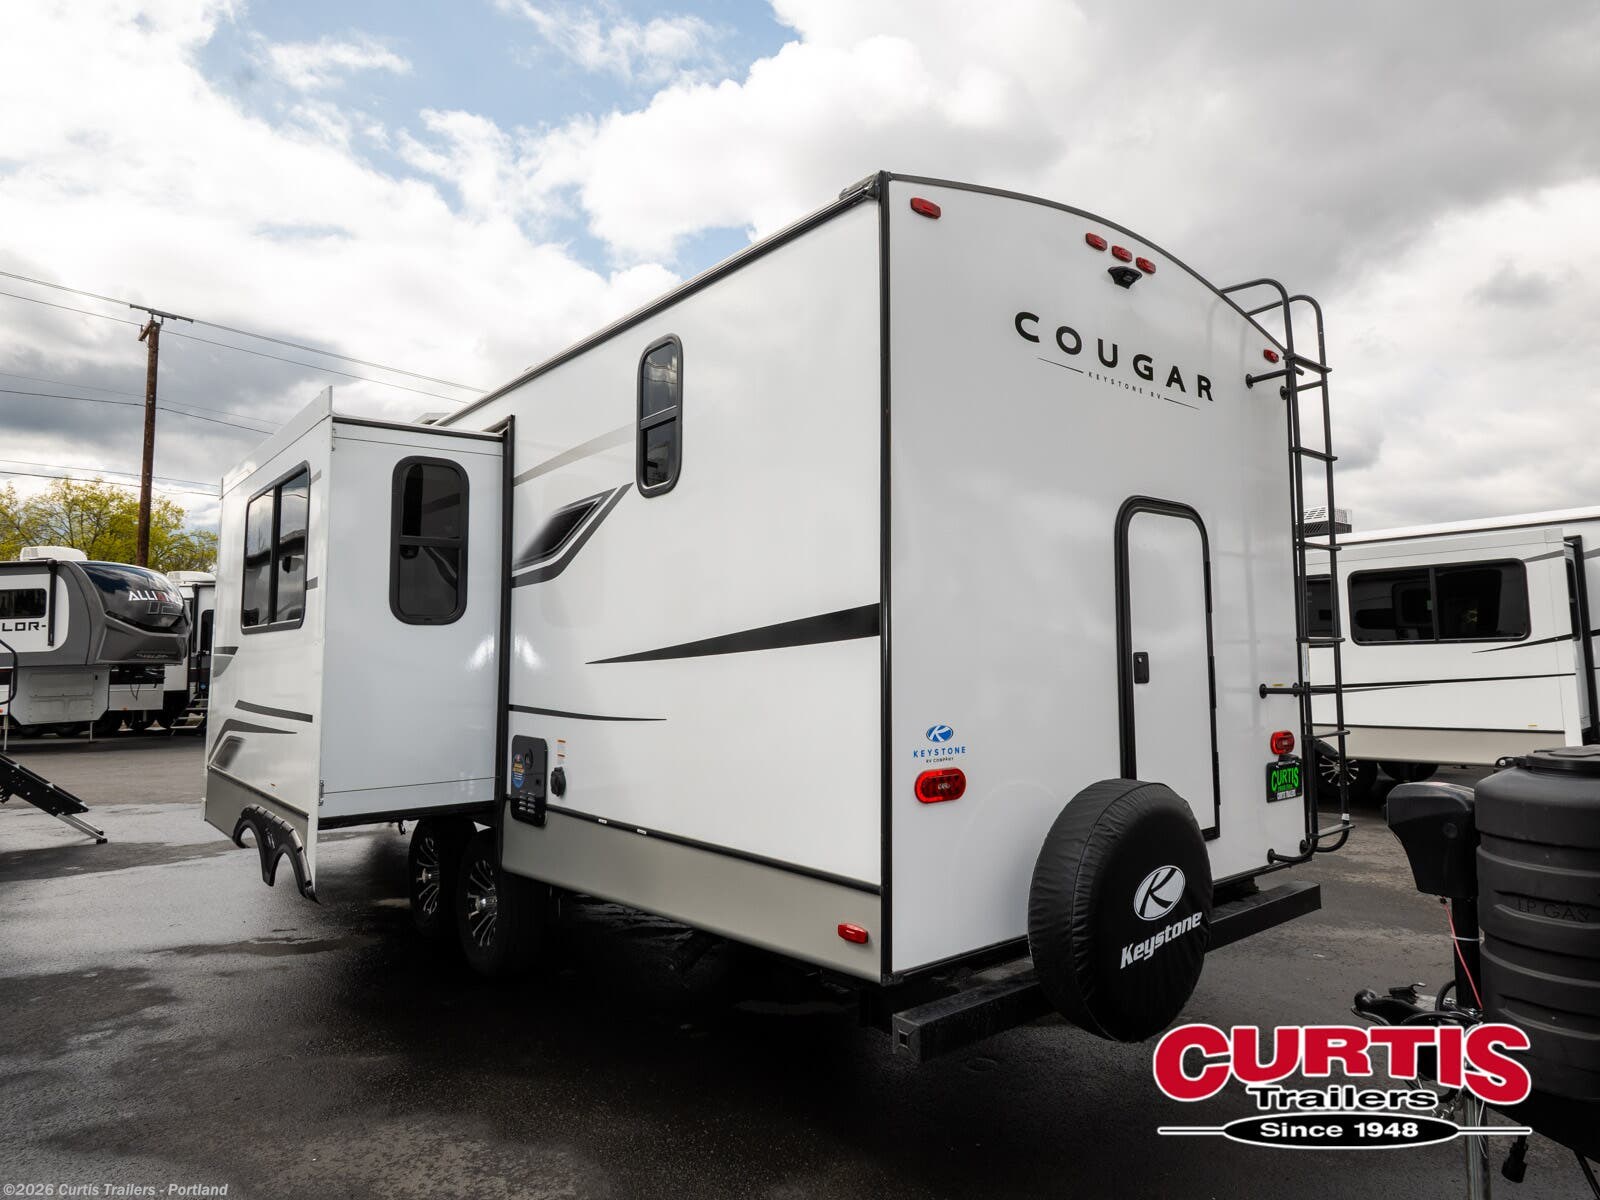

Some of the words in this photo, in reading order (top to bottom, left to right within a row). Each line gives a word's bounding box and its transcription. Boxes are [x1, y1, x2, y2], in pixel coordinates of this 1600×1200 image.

[1014, 311, 1214, 402] COUGAR
[1088, 372, 1143, 395] KEYSTONE
[1150, 391, 1162, 400] RV
[913, 746, 966, 758] KEYSTONE
[1271, 767, 1299, 792] CURTIS
[1120, 911, 1203, 969] Keystone
